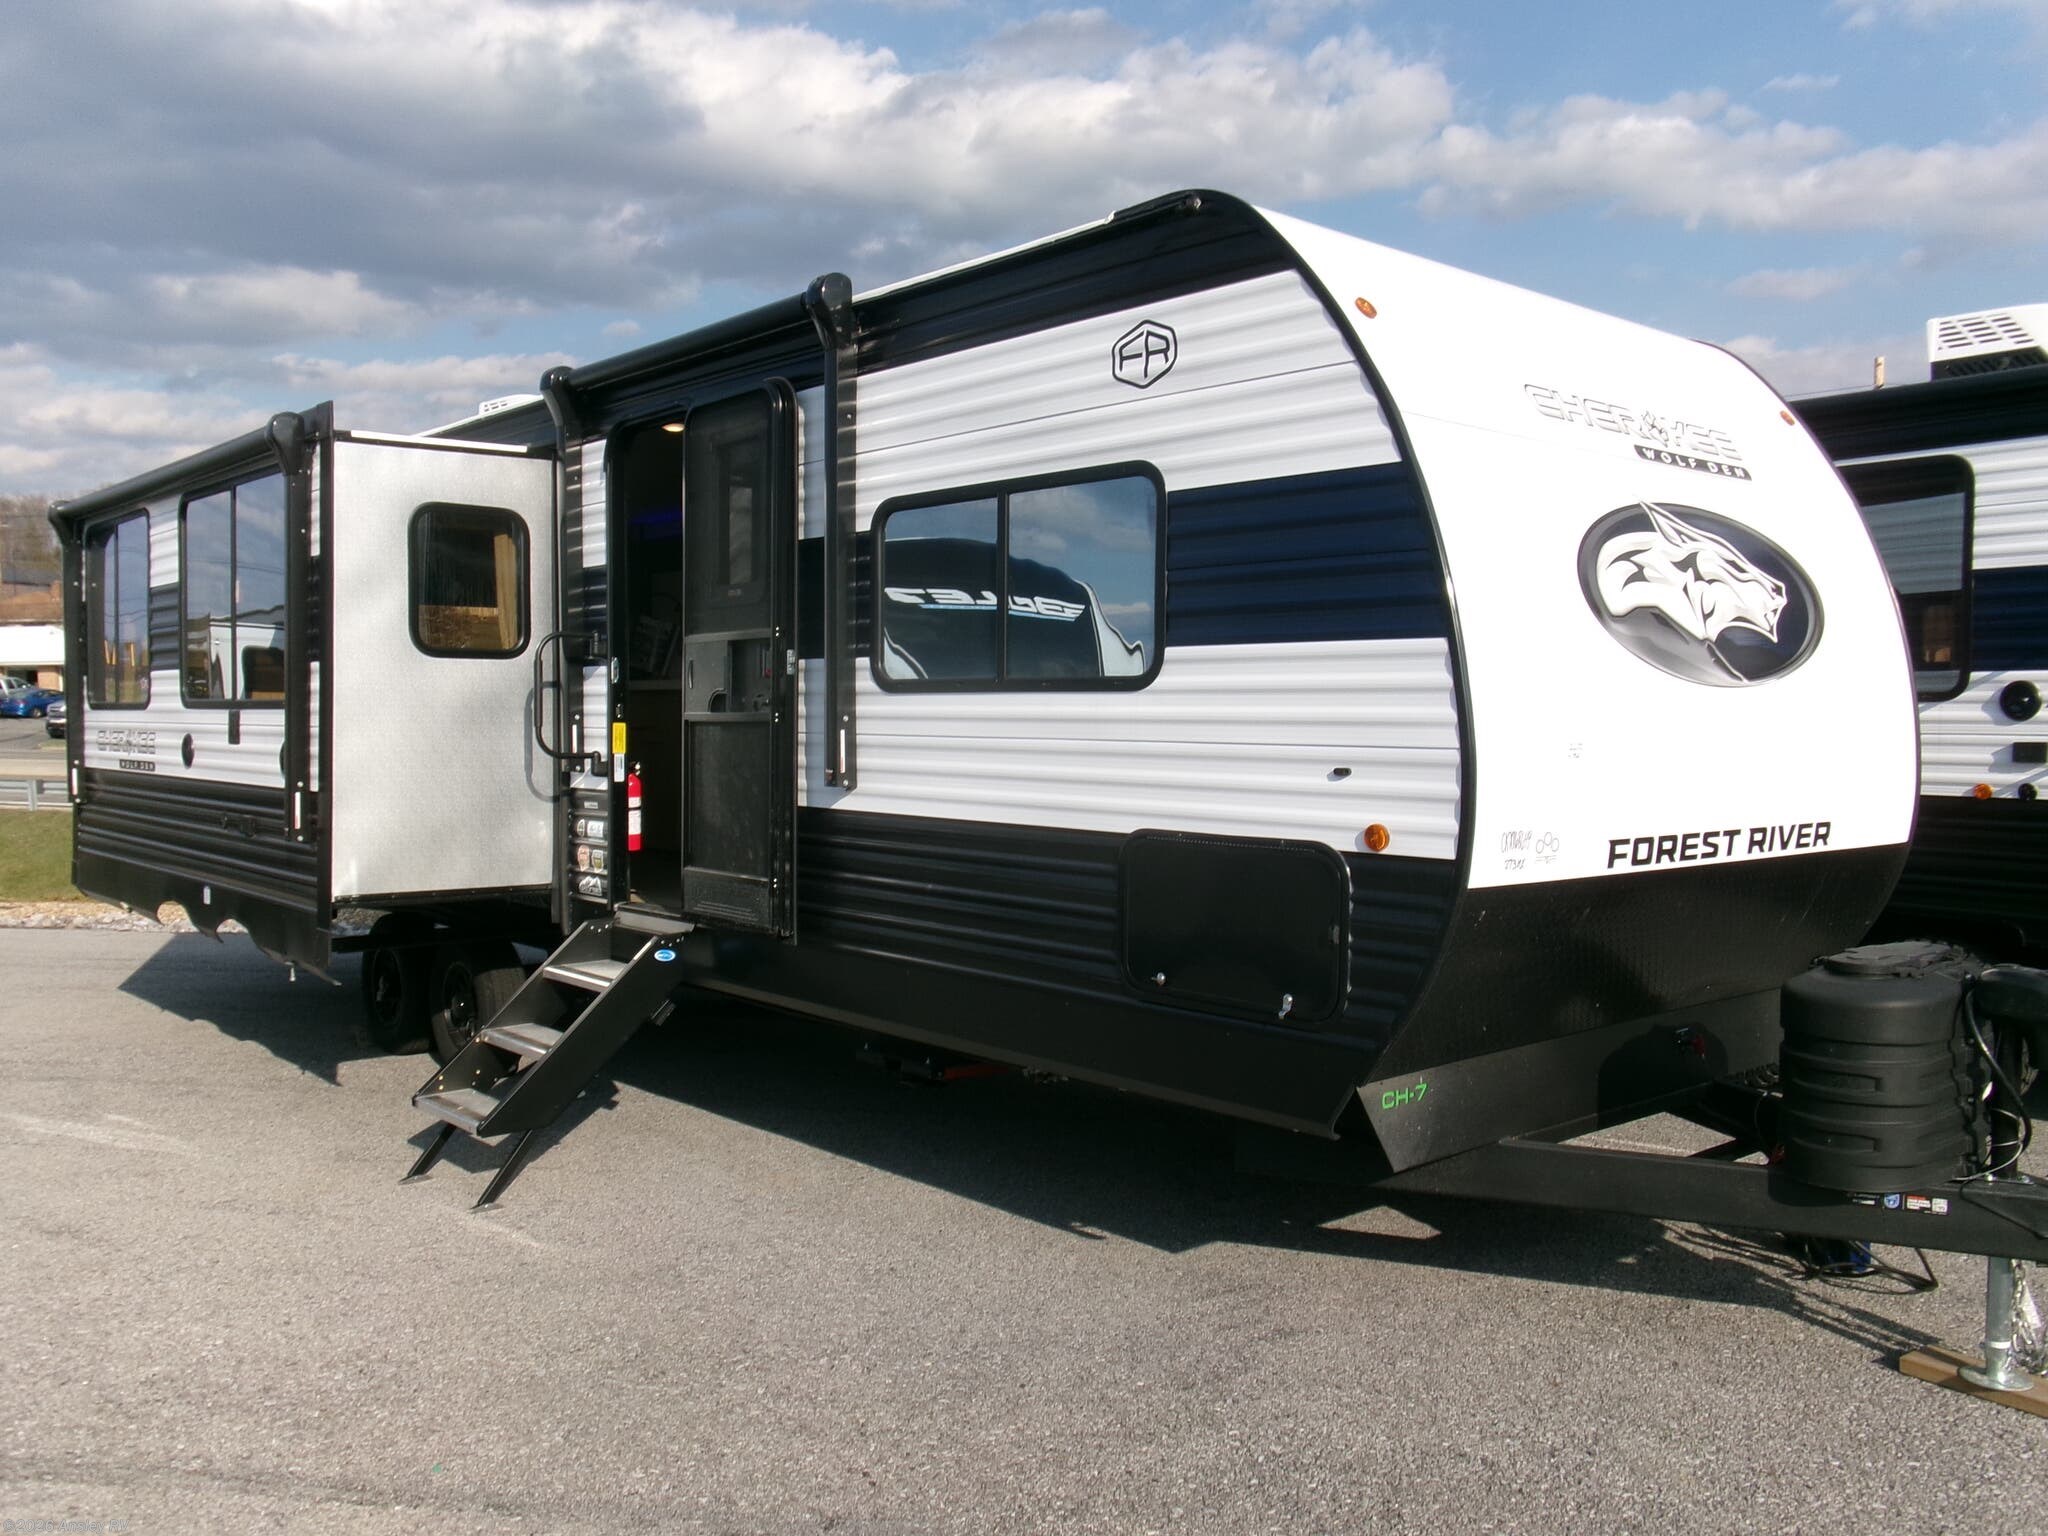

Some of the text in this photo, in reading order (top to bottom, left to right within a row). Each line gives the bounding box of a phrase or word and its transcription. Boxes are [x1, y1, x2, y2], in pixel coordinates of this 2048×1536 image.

[1118, 328, 1171, 379] FR
[1641, 447, 1746, 478] WOLF DEN
[1607, 821, 1831, 869] FOREST RIVER
